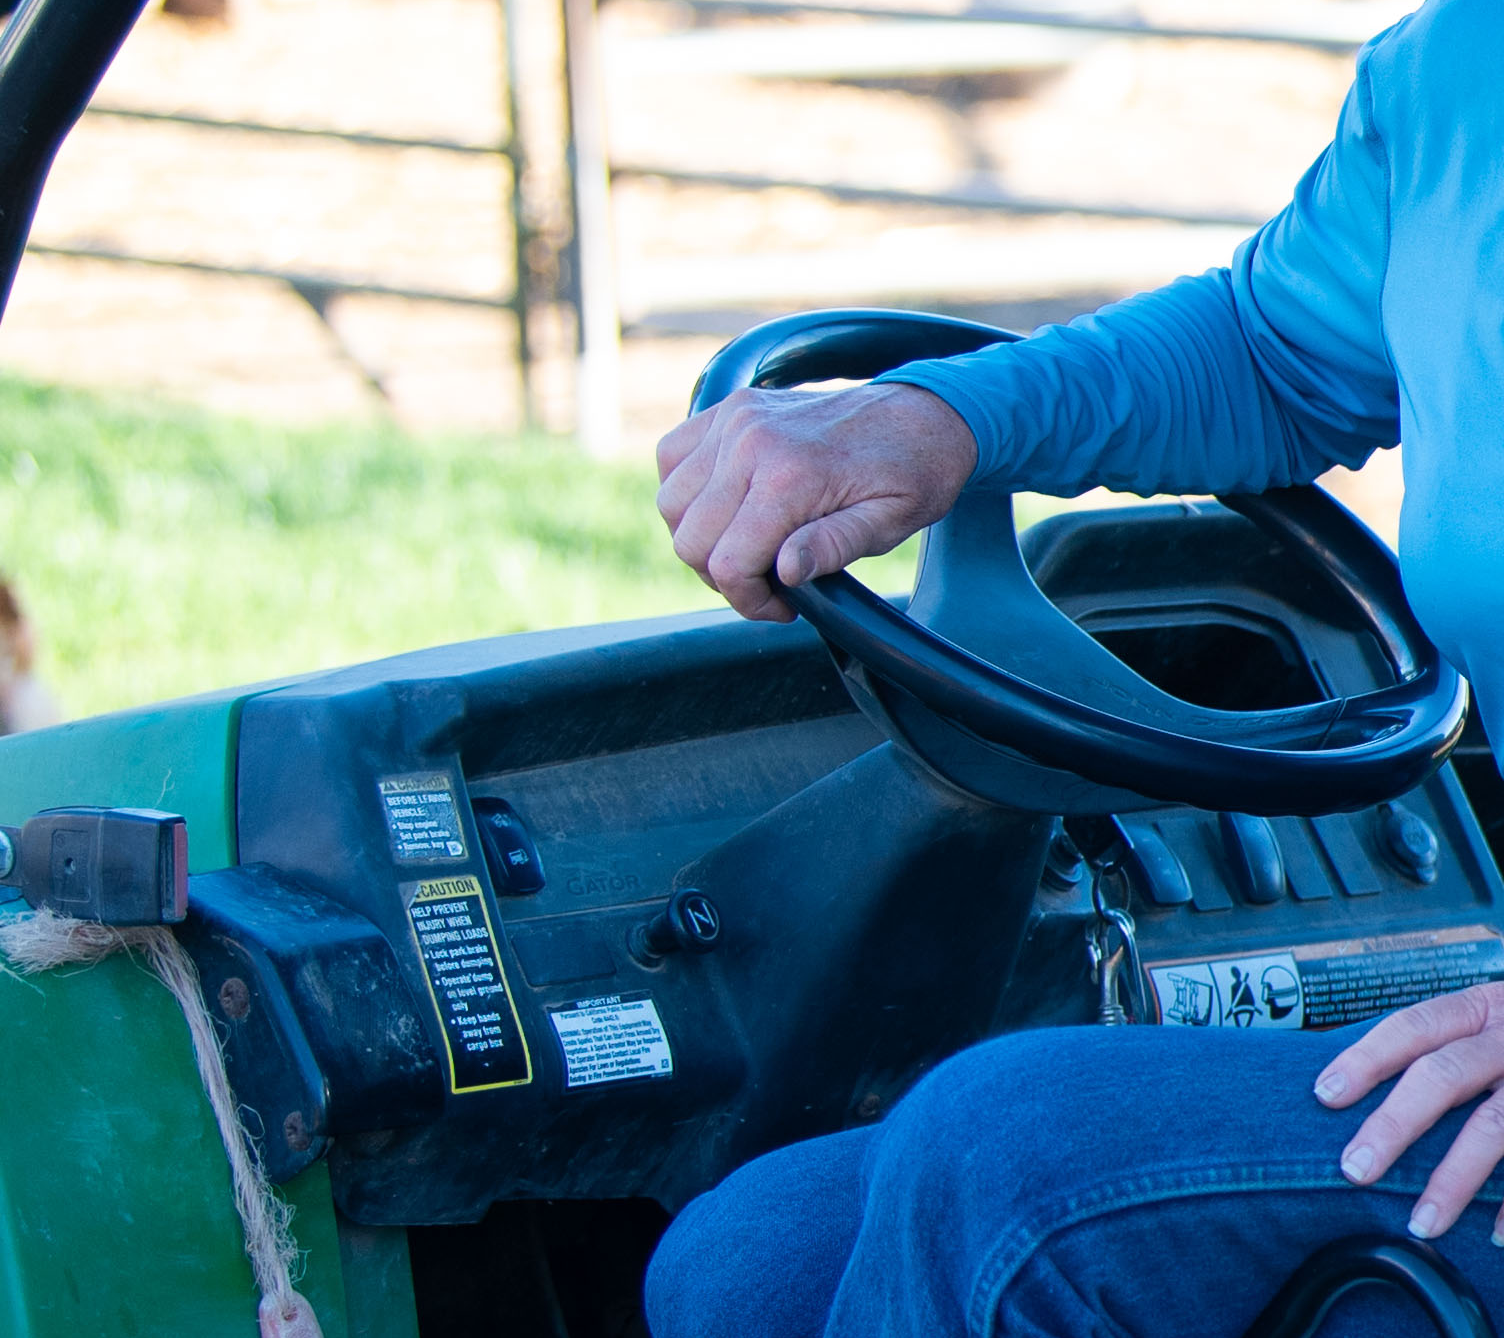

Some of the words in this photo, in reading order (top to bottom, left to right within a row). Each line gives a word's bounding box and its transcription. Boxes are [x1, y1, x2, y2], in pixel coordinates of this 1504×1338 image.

[386, 794, 418, 806] BEFORE
[421, 879, 476, 898] CAUTION
[567, 874, 641, 896] GATOR
[411, 906, 432, 918] HELP
[432, 901, 470, 915] PREVENT
[416, 918, 446, 932] INJURY
[445, 915, 473, 928] WHEN
[422, 930, 462, 946] DUMPING
[460, 927, 489, 940] LOADS
[429, 949, 448, 959] Lock
[434, 961, 460, 972] before
[576, 995, 622, 1008] IMPORTANT
[456, 1016, 478, 1026] Keep
[476, 1012, 501, 1023] hands
[462, 1028, 482, 1039] away
[482, 1026, 502, 1036] from
[466, 1042, 489, 1052] cargo
